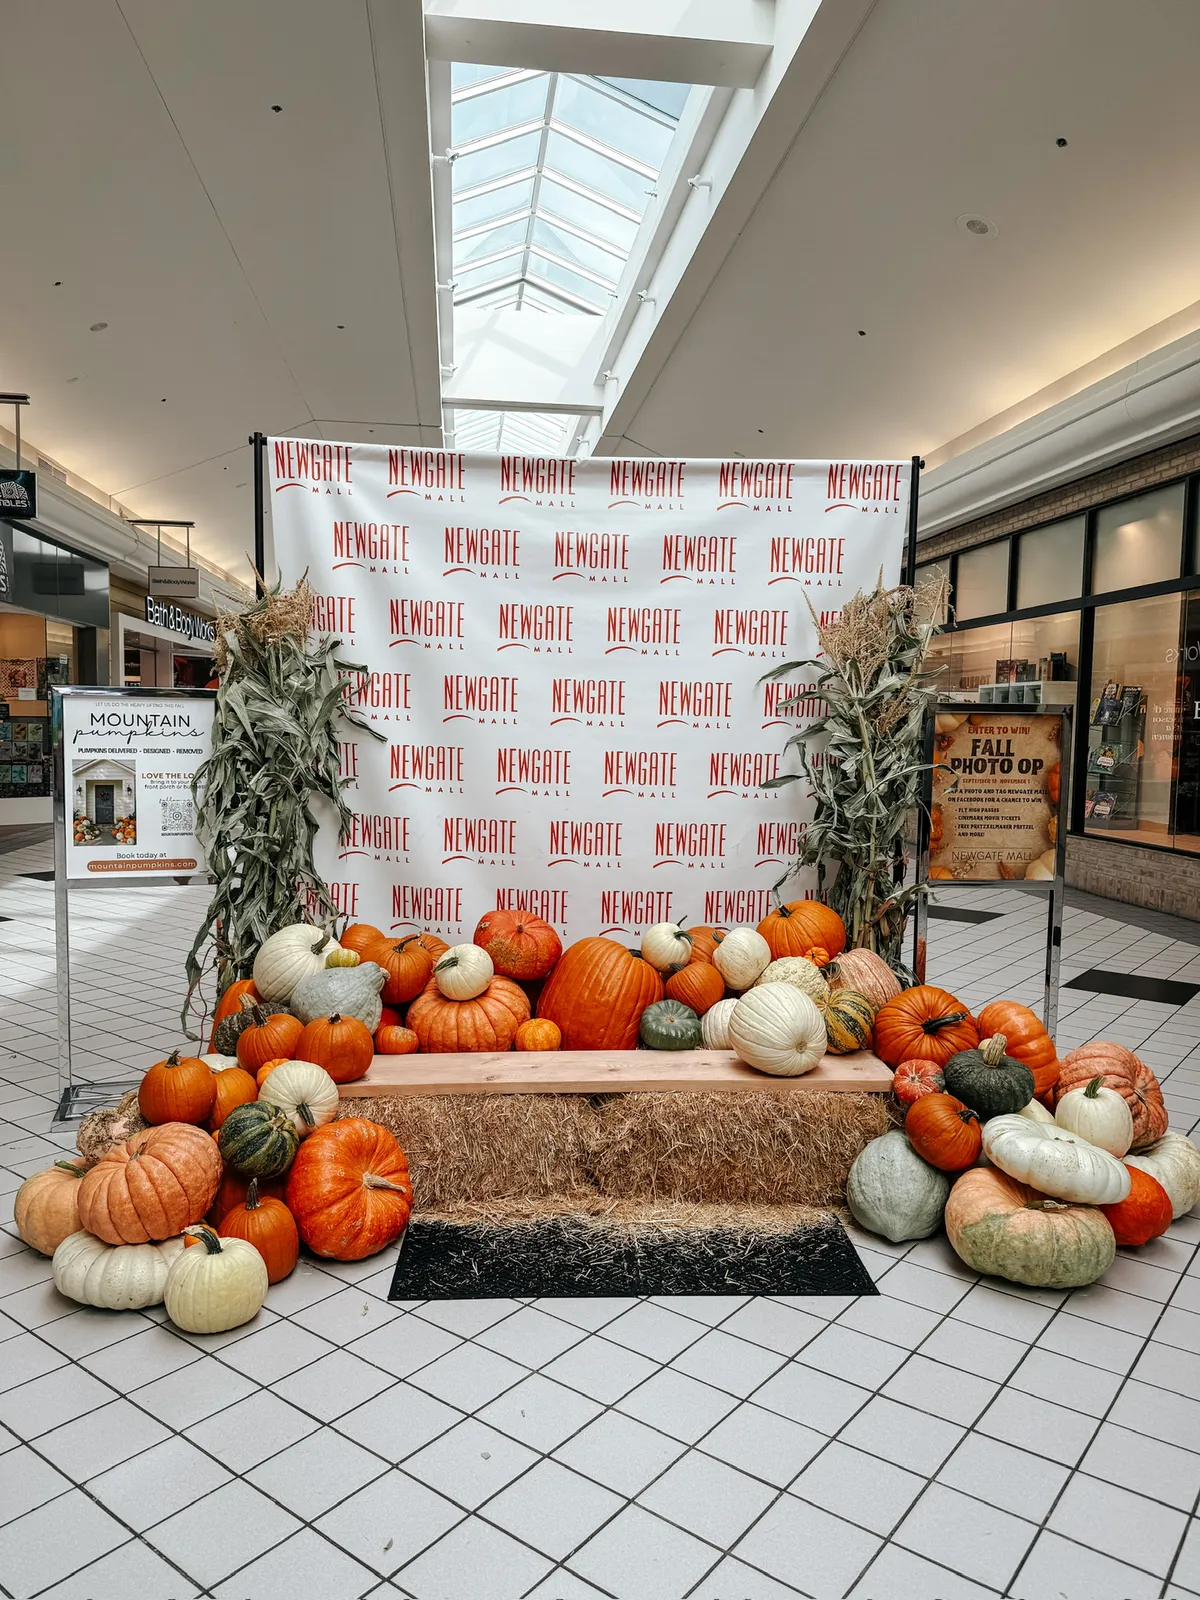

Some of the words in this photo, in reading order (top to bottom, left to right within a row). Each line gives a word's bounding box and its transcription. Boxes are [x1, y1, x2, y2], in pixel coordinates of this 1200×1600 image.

[274, 441, 352, 483] NEWGATE
[388, 449, 465, 490] NEWGATE
[501, 456, 575, 495] NEWGATE
[610, 461, 686, 498] NEWGATE
[312, 486, 353, 495] MALL
[425, 494, 465, 502] MALL
[719, 462, 795, 499] NEWGATE
[827, 463, 903, 501] NEWGATE
[334, 522, 409, 561] NEWGATE
[445, 527, 520, 566] NEWGATE
[554, 532, 630, 570] NEWGATE
[663, 535, 737, 573] NEWGATE
[770, 537, 845, 574] NEWGATE
[370, 566, 409, 574] MALL
[312, 596, 356, 633] GATE
[389, 599, 464, 638] NEWGATE
[499, 604, 573, 642] NEWGATE
[607, 607, 681, 645] NEWGATE
[714, 610, 788, 646] NEWGATE
[444, 675, 518, 712] NEWGATE
[552, 679, 626, 716] NEWGATE
[659, 681, 732, 718] NEWGATE
[73, 721, 205, 744] pumpkins
[91, 713, 190, 727] MOUNTAIN
[968, 726, 994, 735] ENTER
[1011, 726, 1031, 735] WIN!
[390, 745, 464, 781] NEWGATE
[497, 748, 571, 784] NEWGATE
[971, 739, 1015, 757] FALL
[604, 751, 677, 787] NEWGATE
[710, 753, 781, 787] NEWGATE
[951, 758, 1013, 775] PHOTO
[1018, 758, 1044, 775] OP
[444, 818, 517, 855] NEWGATE
[549, 821, 623, 857] NEWGATE
[655, 823, 727, 857] NEWGATE
[88, 861, 196, 871] mountainpumpkins.com
[136, 852, 157, 860] today
[375, 855, 410, 863] MALL
[952, 851, 1004, 860] NEWGATE
[1006, 852, 1033, 860] MALL
[392, 885, 463, 922] NEWGATE
[601, 890, 673, 925] NEWGATE
